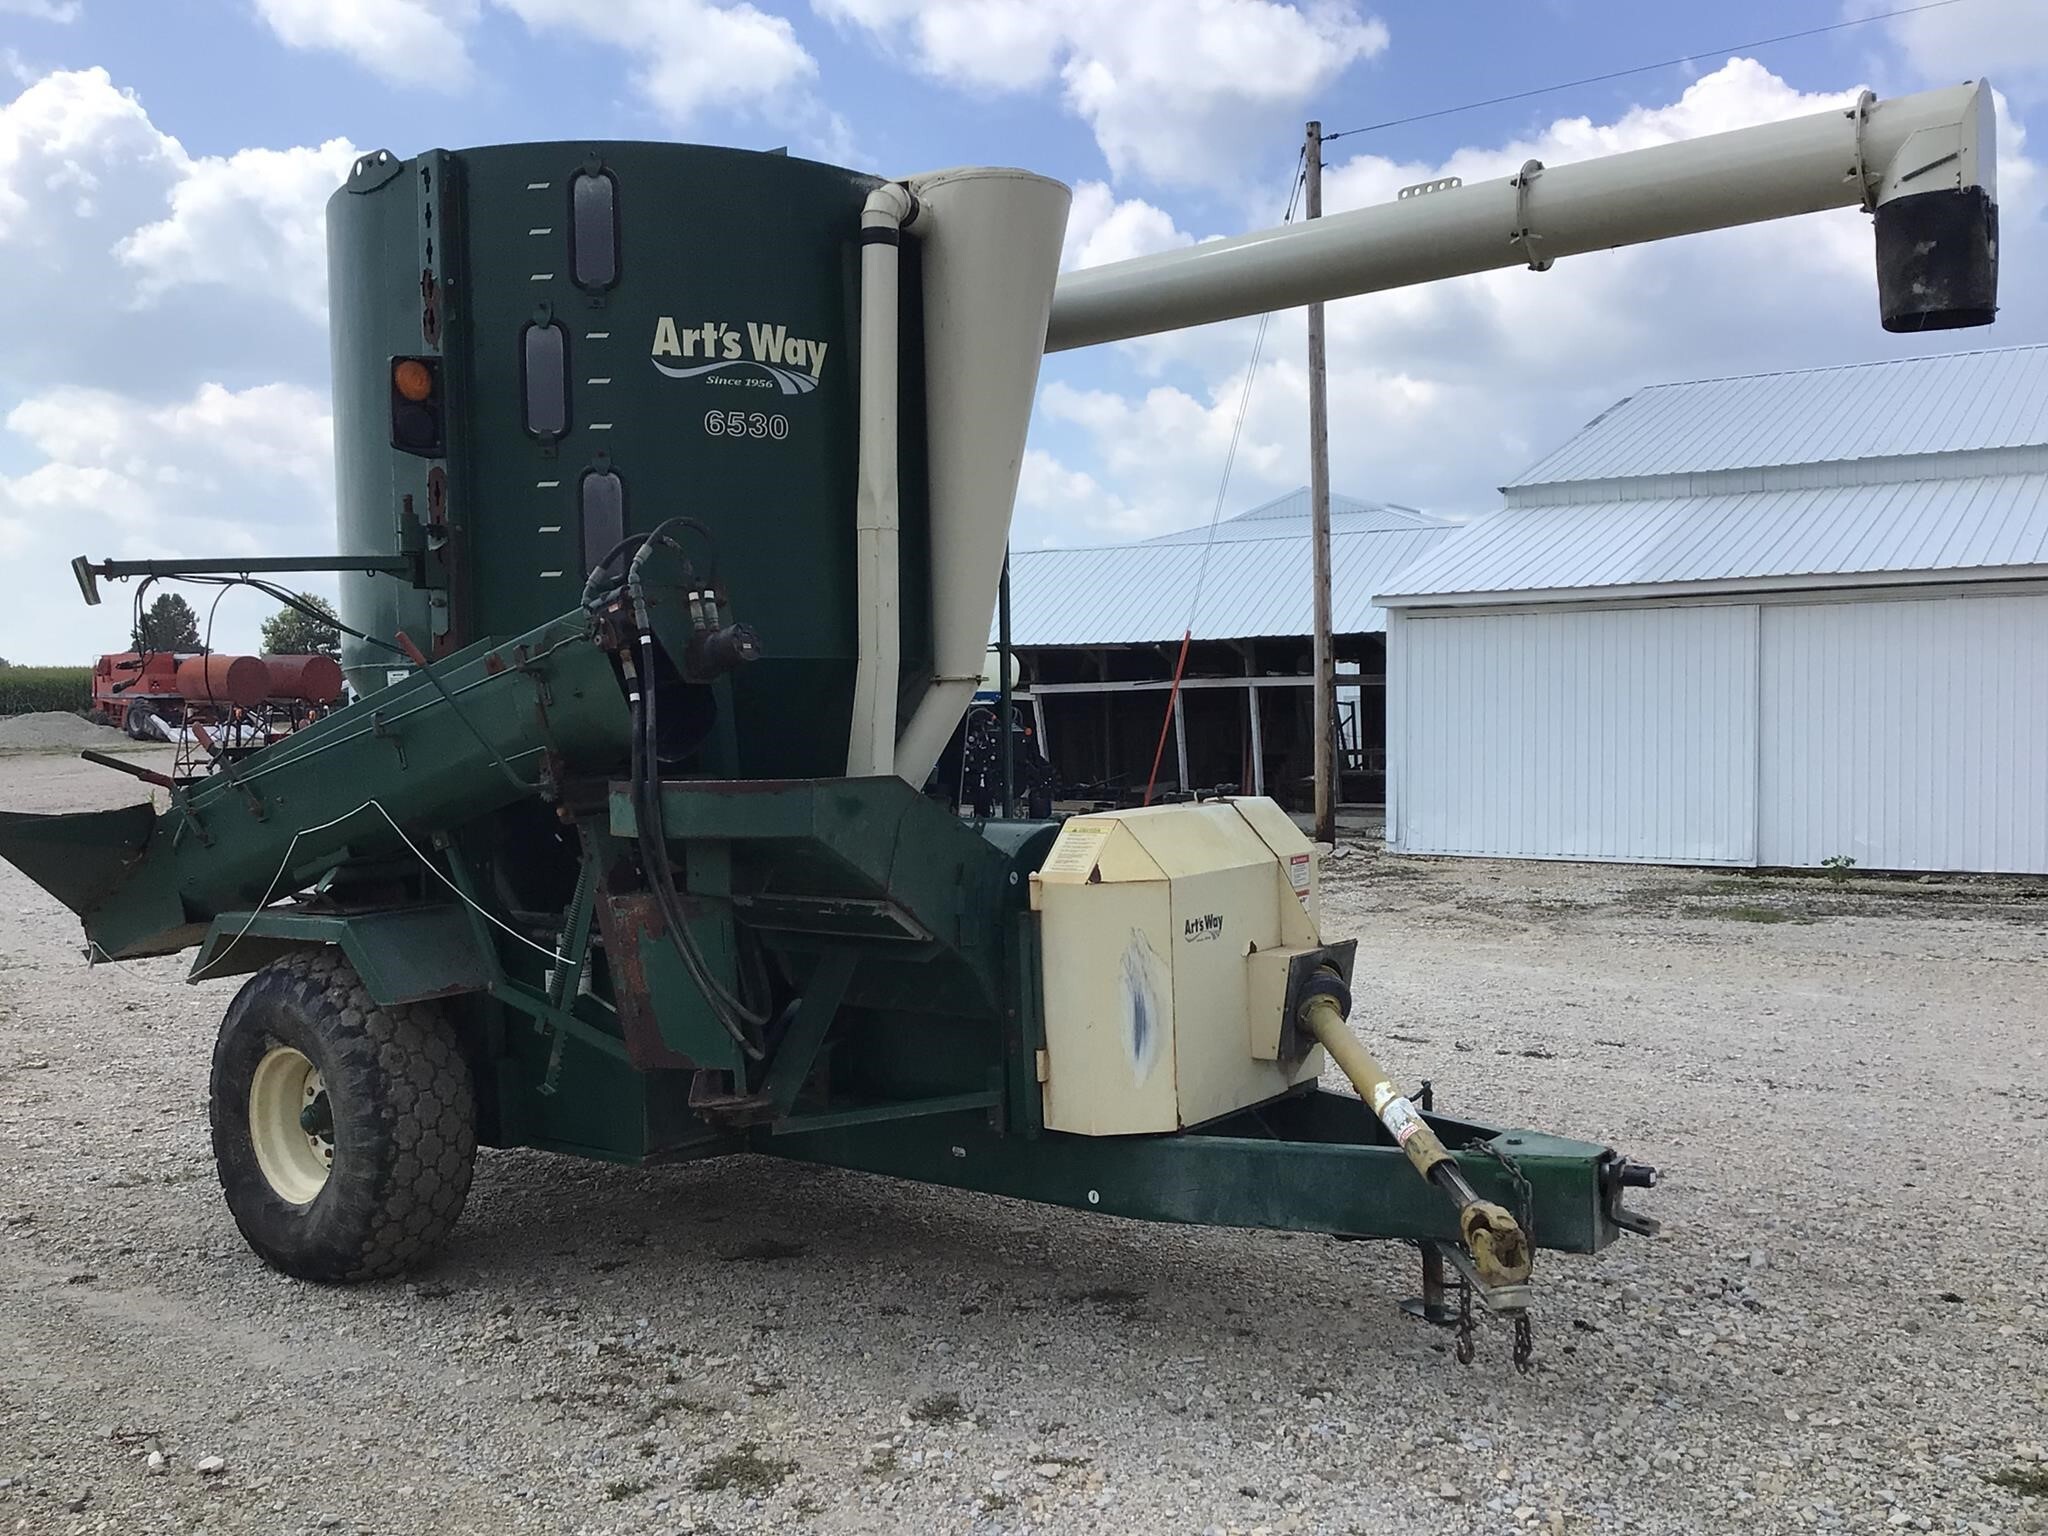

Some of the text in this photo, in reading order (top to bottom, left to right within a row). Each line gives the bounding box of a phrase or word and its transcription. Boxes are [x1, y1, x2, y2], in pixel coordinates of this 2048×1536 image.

[651, 316, 828, 379] Art's Way
[706, 375, 774, 389] Since 1956
[704, 409, 789, 440] 6530
[1204, 913, 1224, 931] Way
